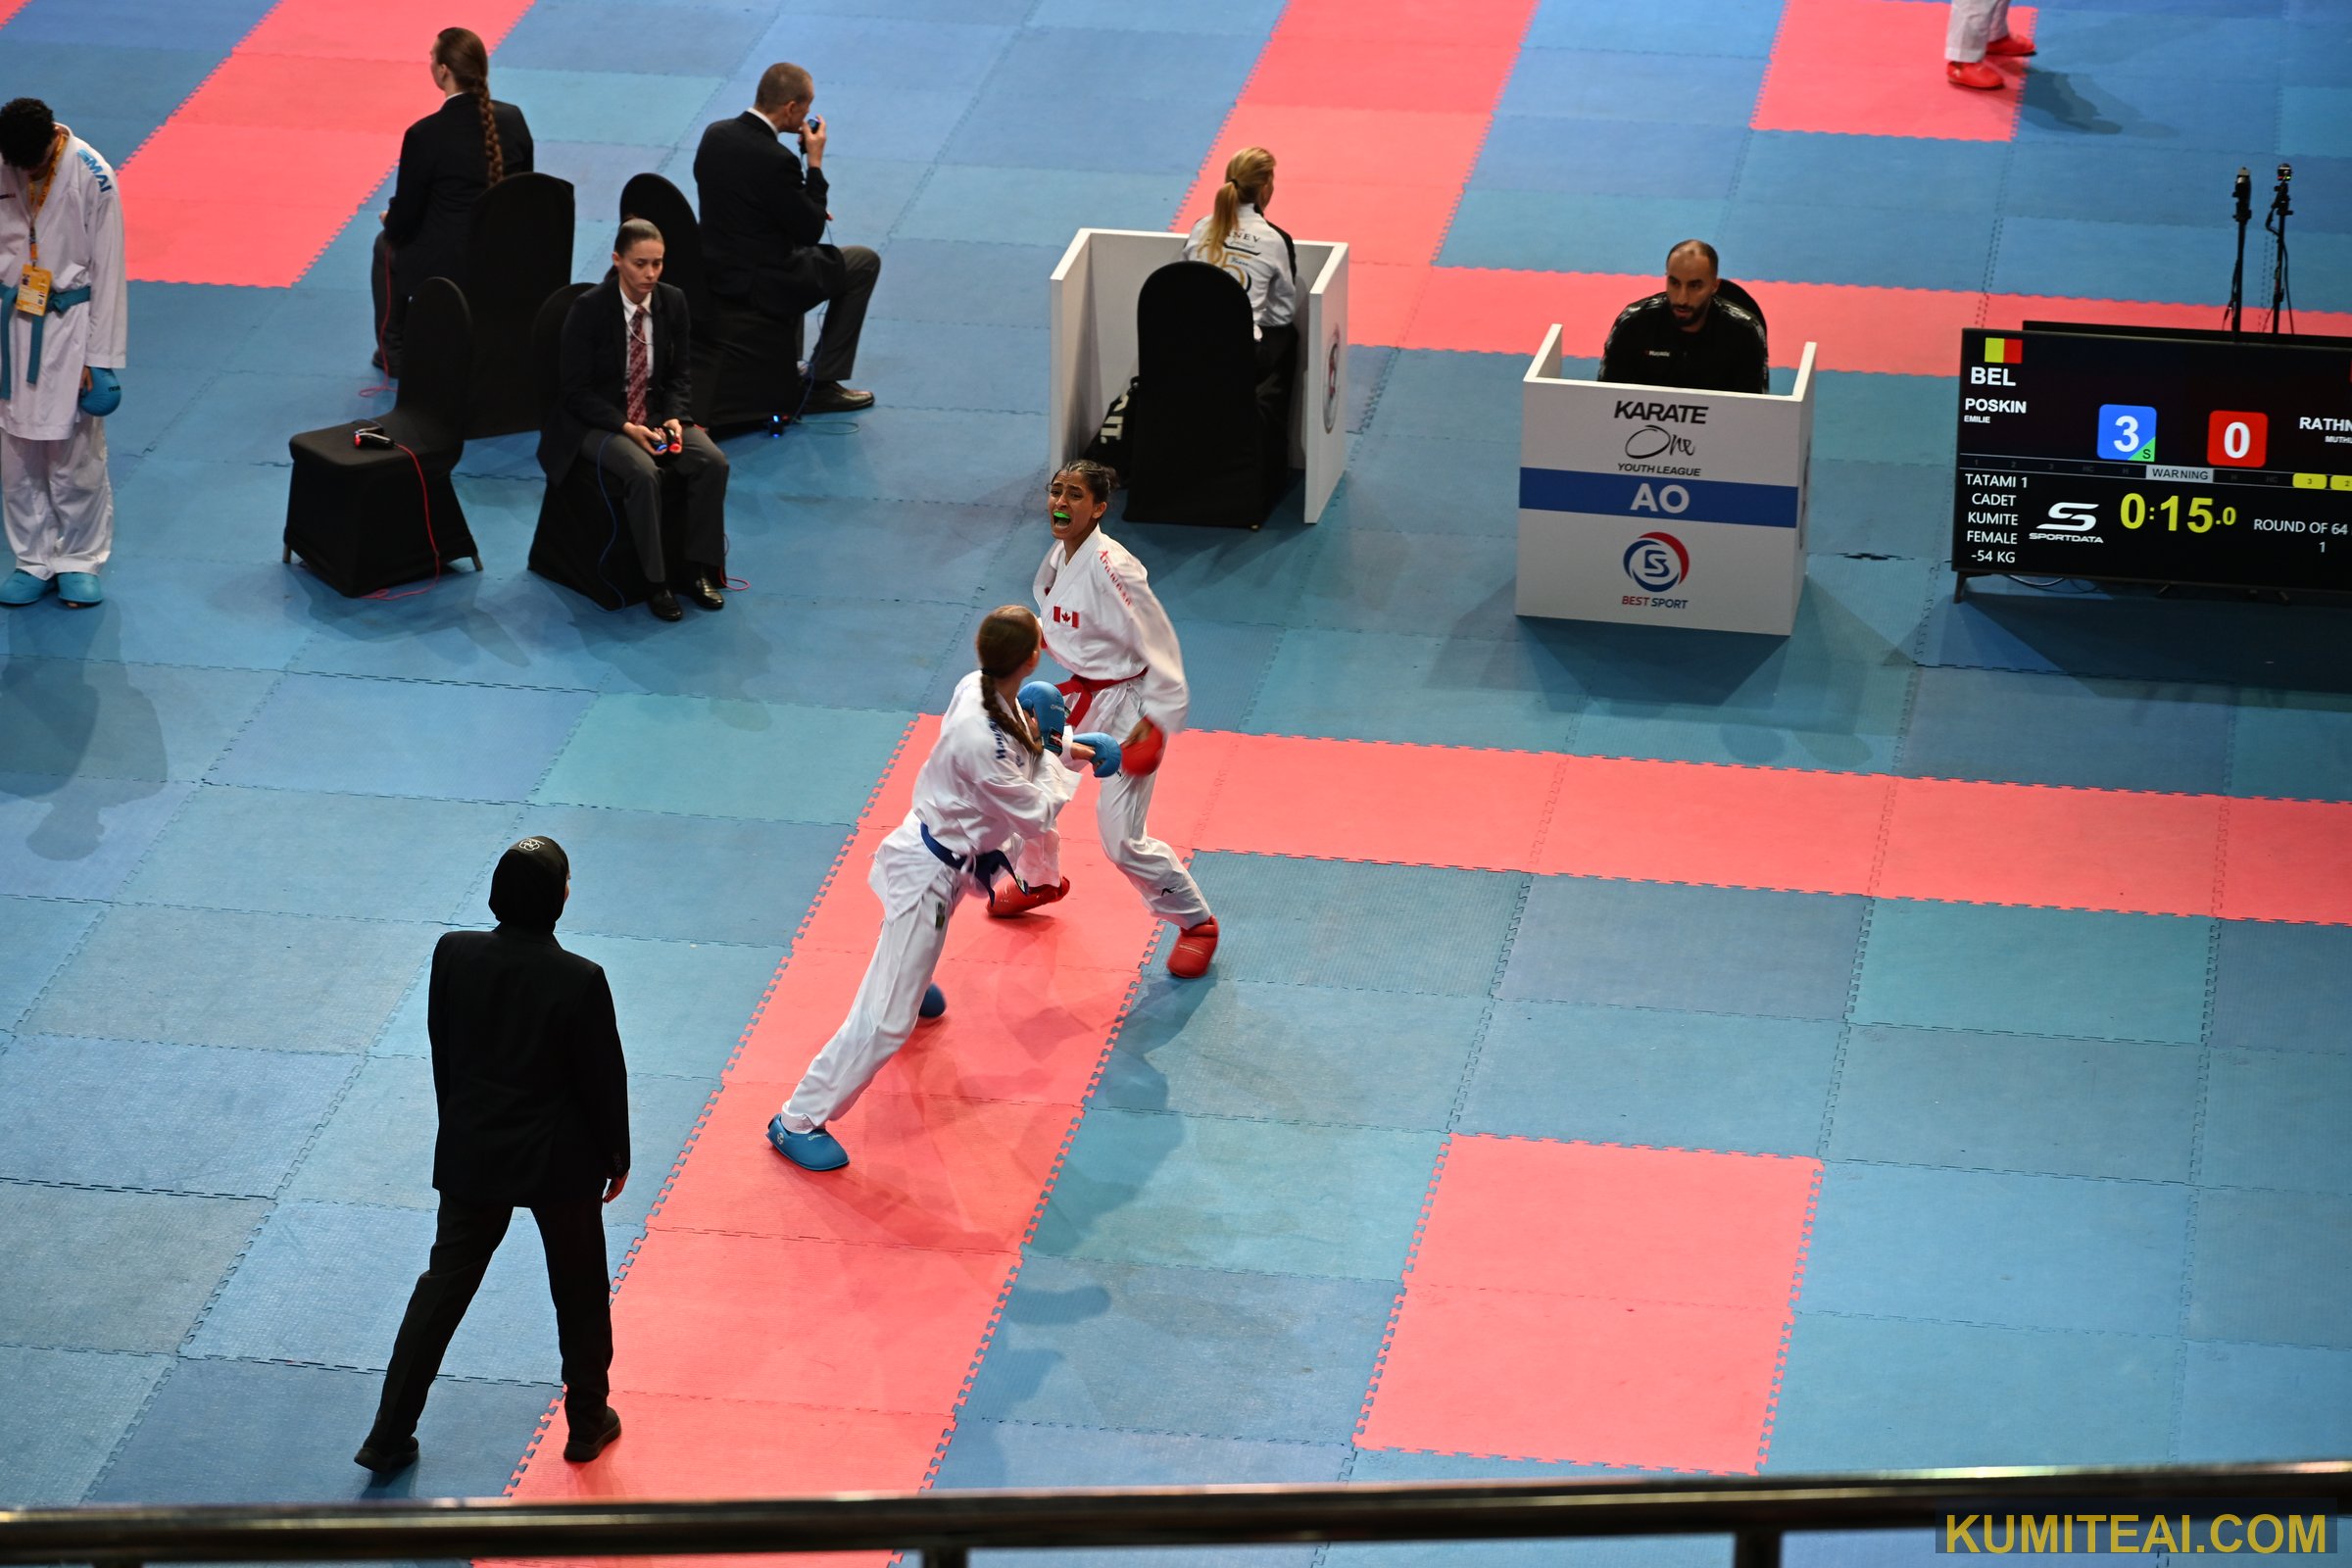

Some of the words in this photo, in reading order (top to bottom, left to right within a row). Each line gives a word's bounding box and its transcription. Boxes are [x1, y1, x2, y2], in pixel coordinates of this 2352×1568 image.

[1971, 366, 2017, 387] BEL
[1613, 400, 1709, 424] KARATE
[1964, 397, 2028, 415] POSKIN
[1963, 415, 1991, 424] EMILIE
[1625, 424, 1695, 459] One
[2113, 415, 2140, 453] 3
[2224, 421, 2251, 459] 0
[2142, 448, 2152, 460] S
[1618, 463, 1655, 474] YOUTH
[1656, 466, 1700, 476] LEAGUE
[2152, 468, 2208, 480] WARNING
[1964, 473, 2017, 488] TATAMI
[2021, 476, 2028, 488] 1
[1630, 483, 1690, 514] AO
[1971, 492, 2017, 507] CADET
[1967, 512, 2019, 526] KUMITE
[2254, 518, 2306, 532] ROUND
[2309, 521, 2328, 534] OF
[2330, 522, 2348, 535] 64
[1966, 530, 2018, 545] FEMALE
[2029, 532, 2104, 544] SPORTDATA
[2319, 541, 2326, 553] 1
[1971, 550, 1993, 563] -54
[1996, 551, 2016, 564] KG
[1621, 596, 1649, 607] BEST
[1650, 597, 1689, 610] SPORT
